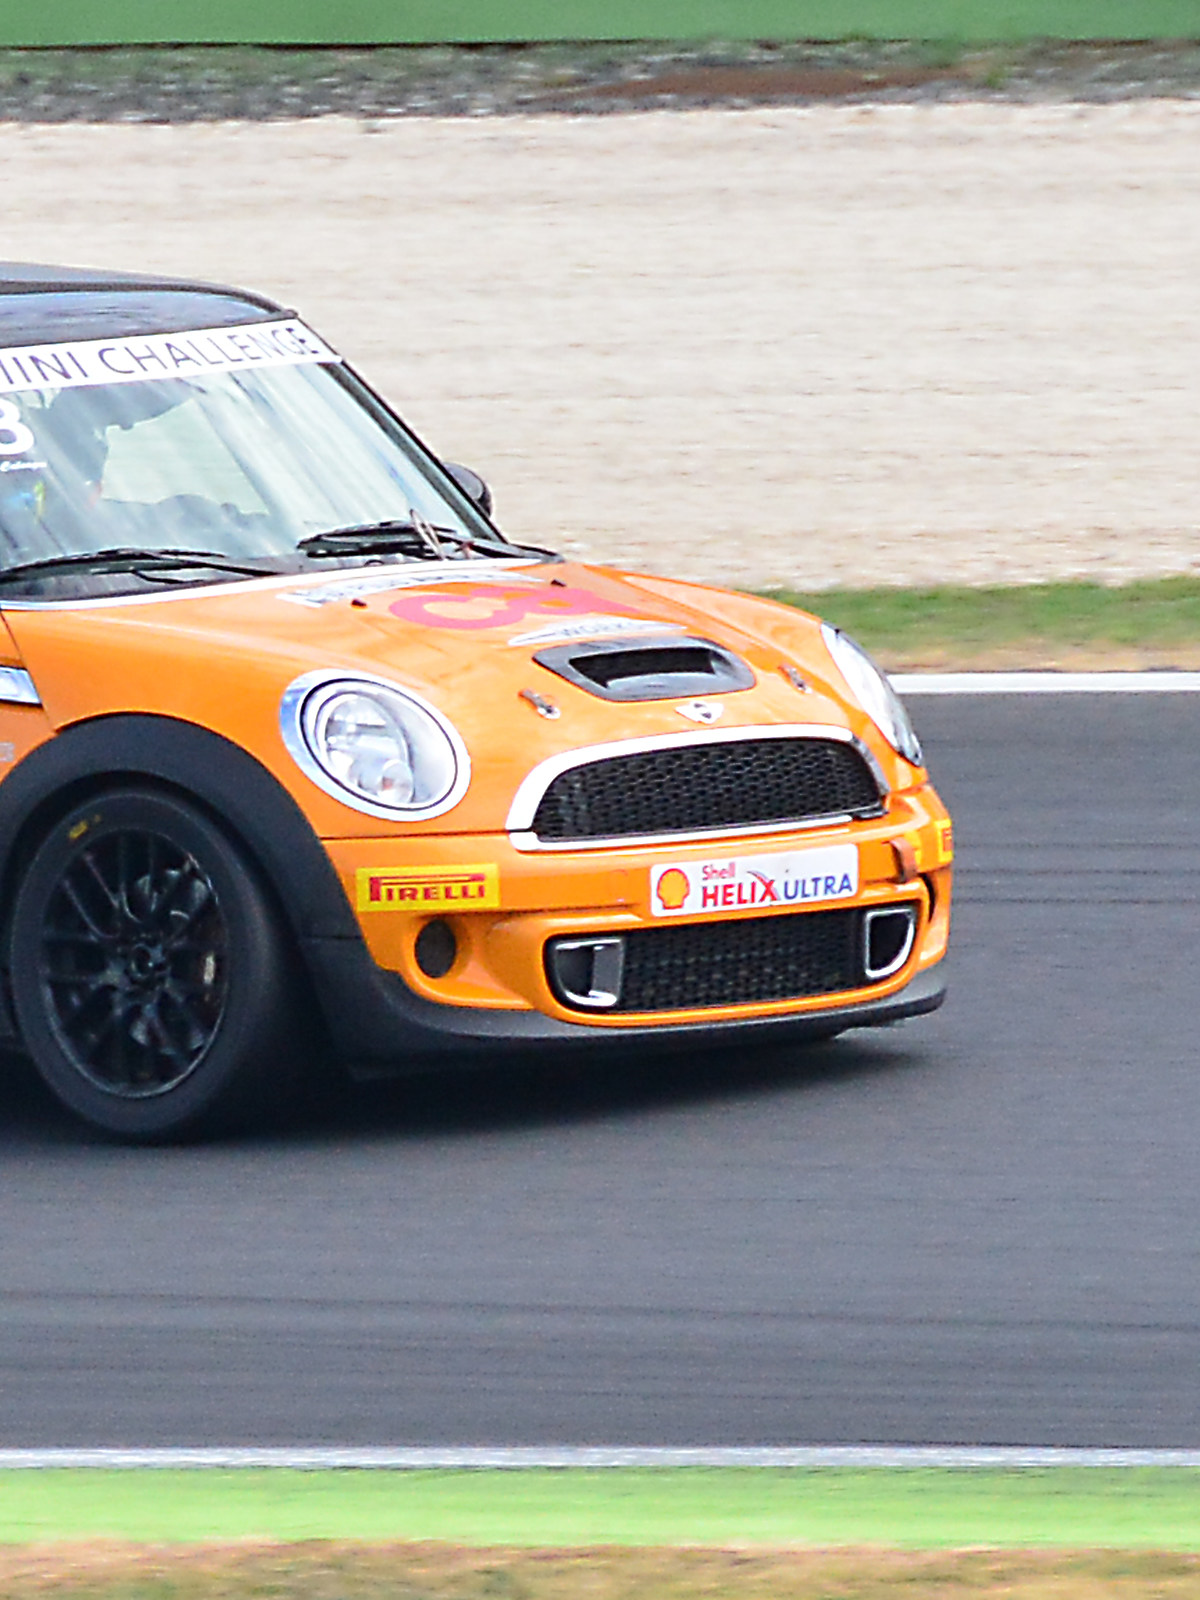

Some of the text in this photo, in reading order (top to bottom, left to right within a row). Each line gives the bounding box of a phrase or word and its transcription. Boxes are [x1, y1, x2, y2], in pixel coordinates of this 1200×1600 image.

[98, 327, 319, 375] CHALLENGE
[369, 873, 485, 902] PIRELLI
[702, 862, 736, 881] Shell
[701, 871, 853, 908] HELIX ULTRA
